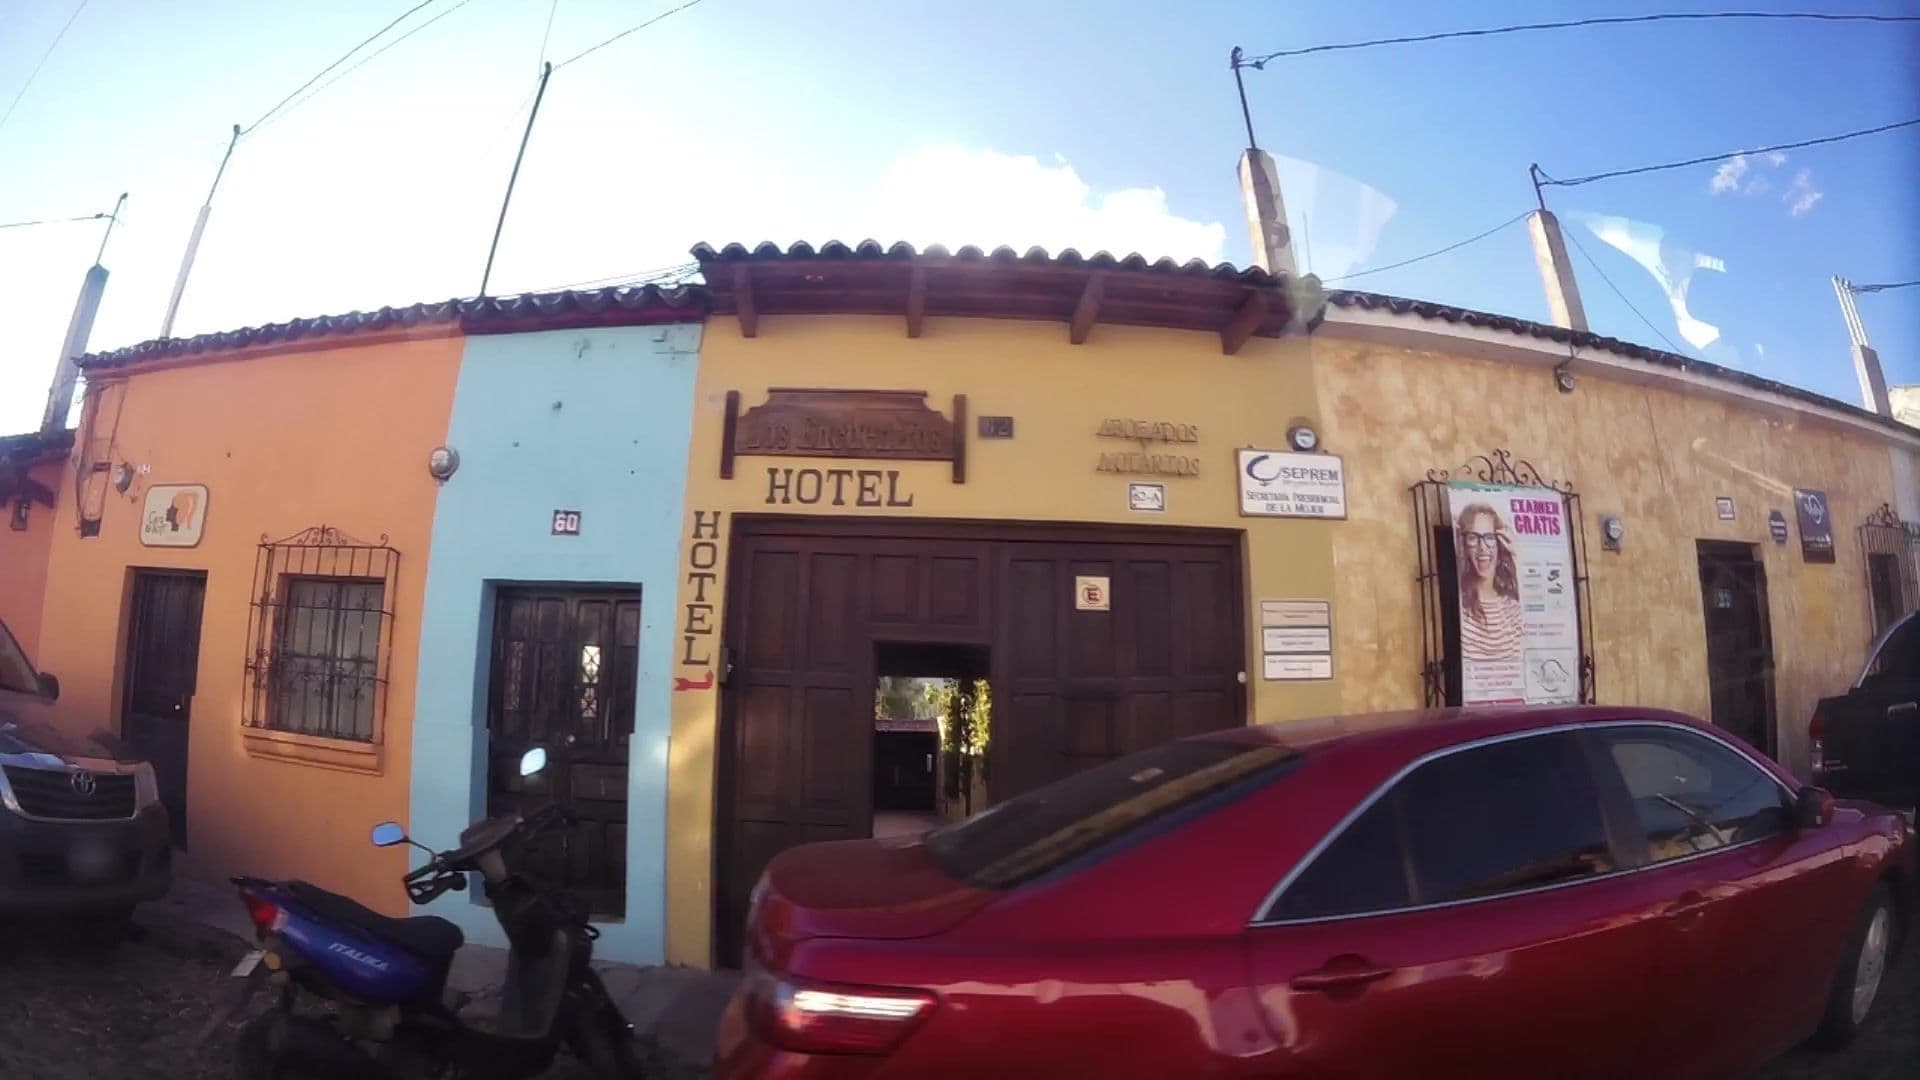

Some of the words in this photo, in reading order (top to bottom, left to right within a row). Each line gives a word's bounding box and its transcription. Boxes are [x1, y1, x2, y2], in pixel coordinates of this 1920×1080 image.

[1281, 467, 1338, 481] SEPREM
[765, 467, 913, 507] HOTEL
[1510, 498, 1560, 515] EXAMEN
[555, 513, 578, 531] 60
[1513, 515, 1561, 536] GRATIS
[682, 511, 721, 665] HOTEL
